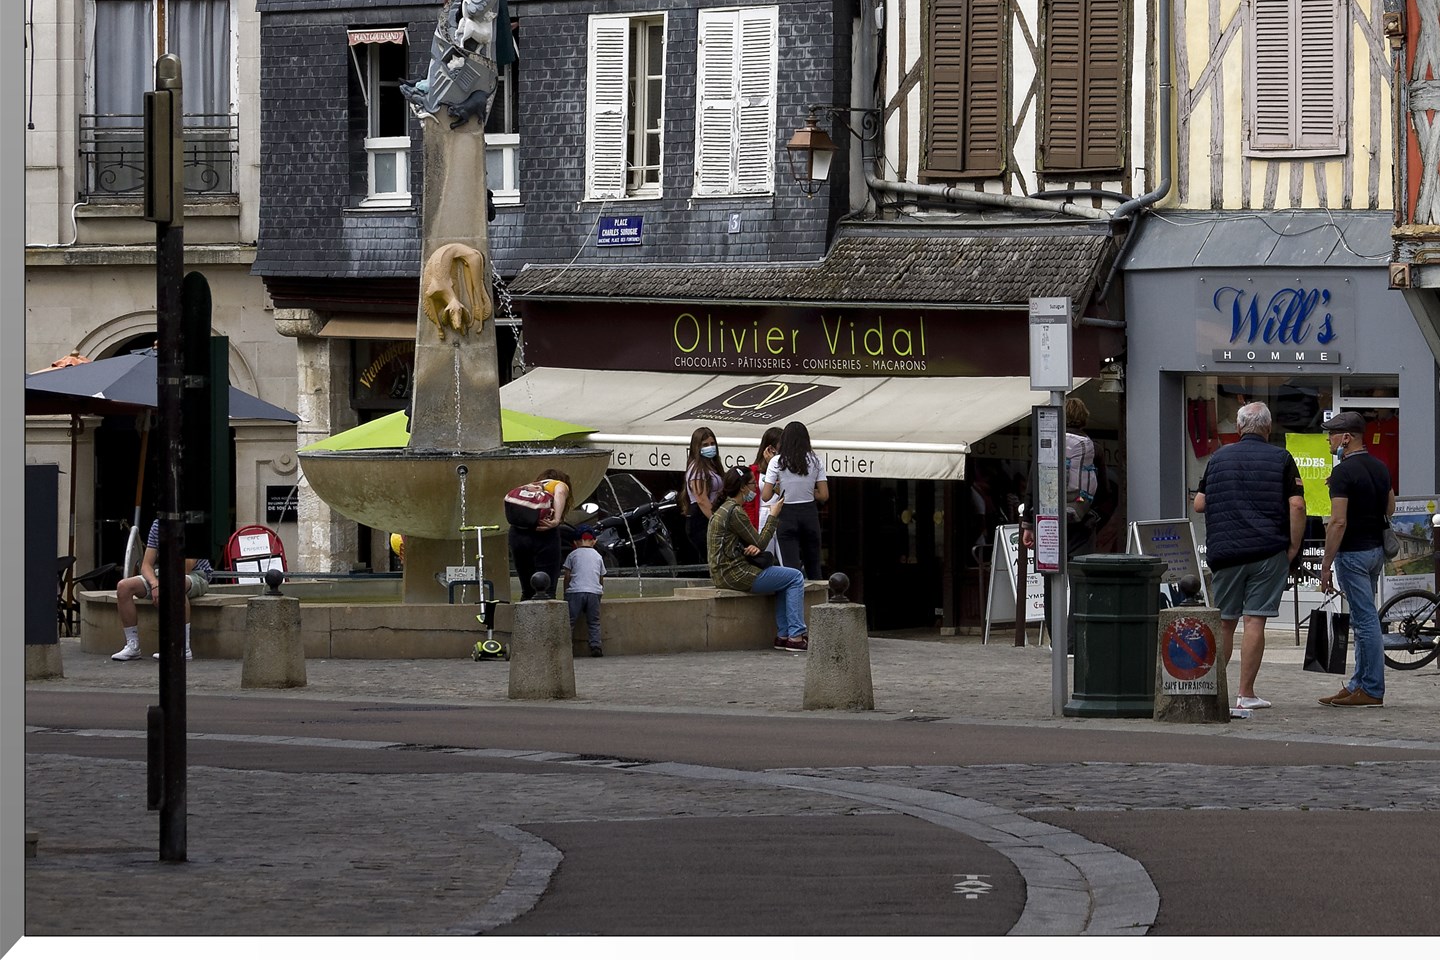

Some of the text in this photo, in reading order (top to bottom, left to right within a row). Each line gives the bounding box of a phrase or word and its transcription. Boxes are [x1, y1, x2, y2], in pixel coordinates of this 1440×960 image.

[614, 218, 628, 227] PLACE
[730, 214, 739, 230] 3
[601, 228, 620, 237] CHARLES
[1213, 286, 1337, 345] Will's
[673, 312, 926, 356] Olivier Vidal
[1223, 351, 1328, 361] HOMME
[674, 356, 927, 371] CHOCOLATS PÂTISSERIES CONFISERIES MACARONS
[649, 447, 671, 467] de
[825, 449, 875, 473] latier
[1294, 457, 1325, 467] OLDES
[1178, 681, 1215, 690] LIVRAISONS
